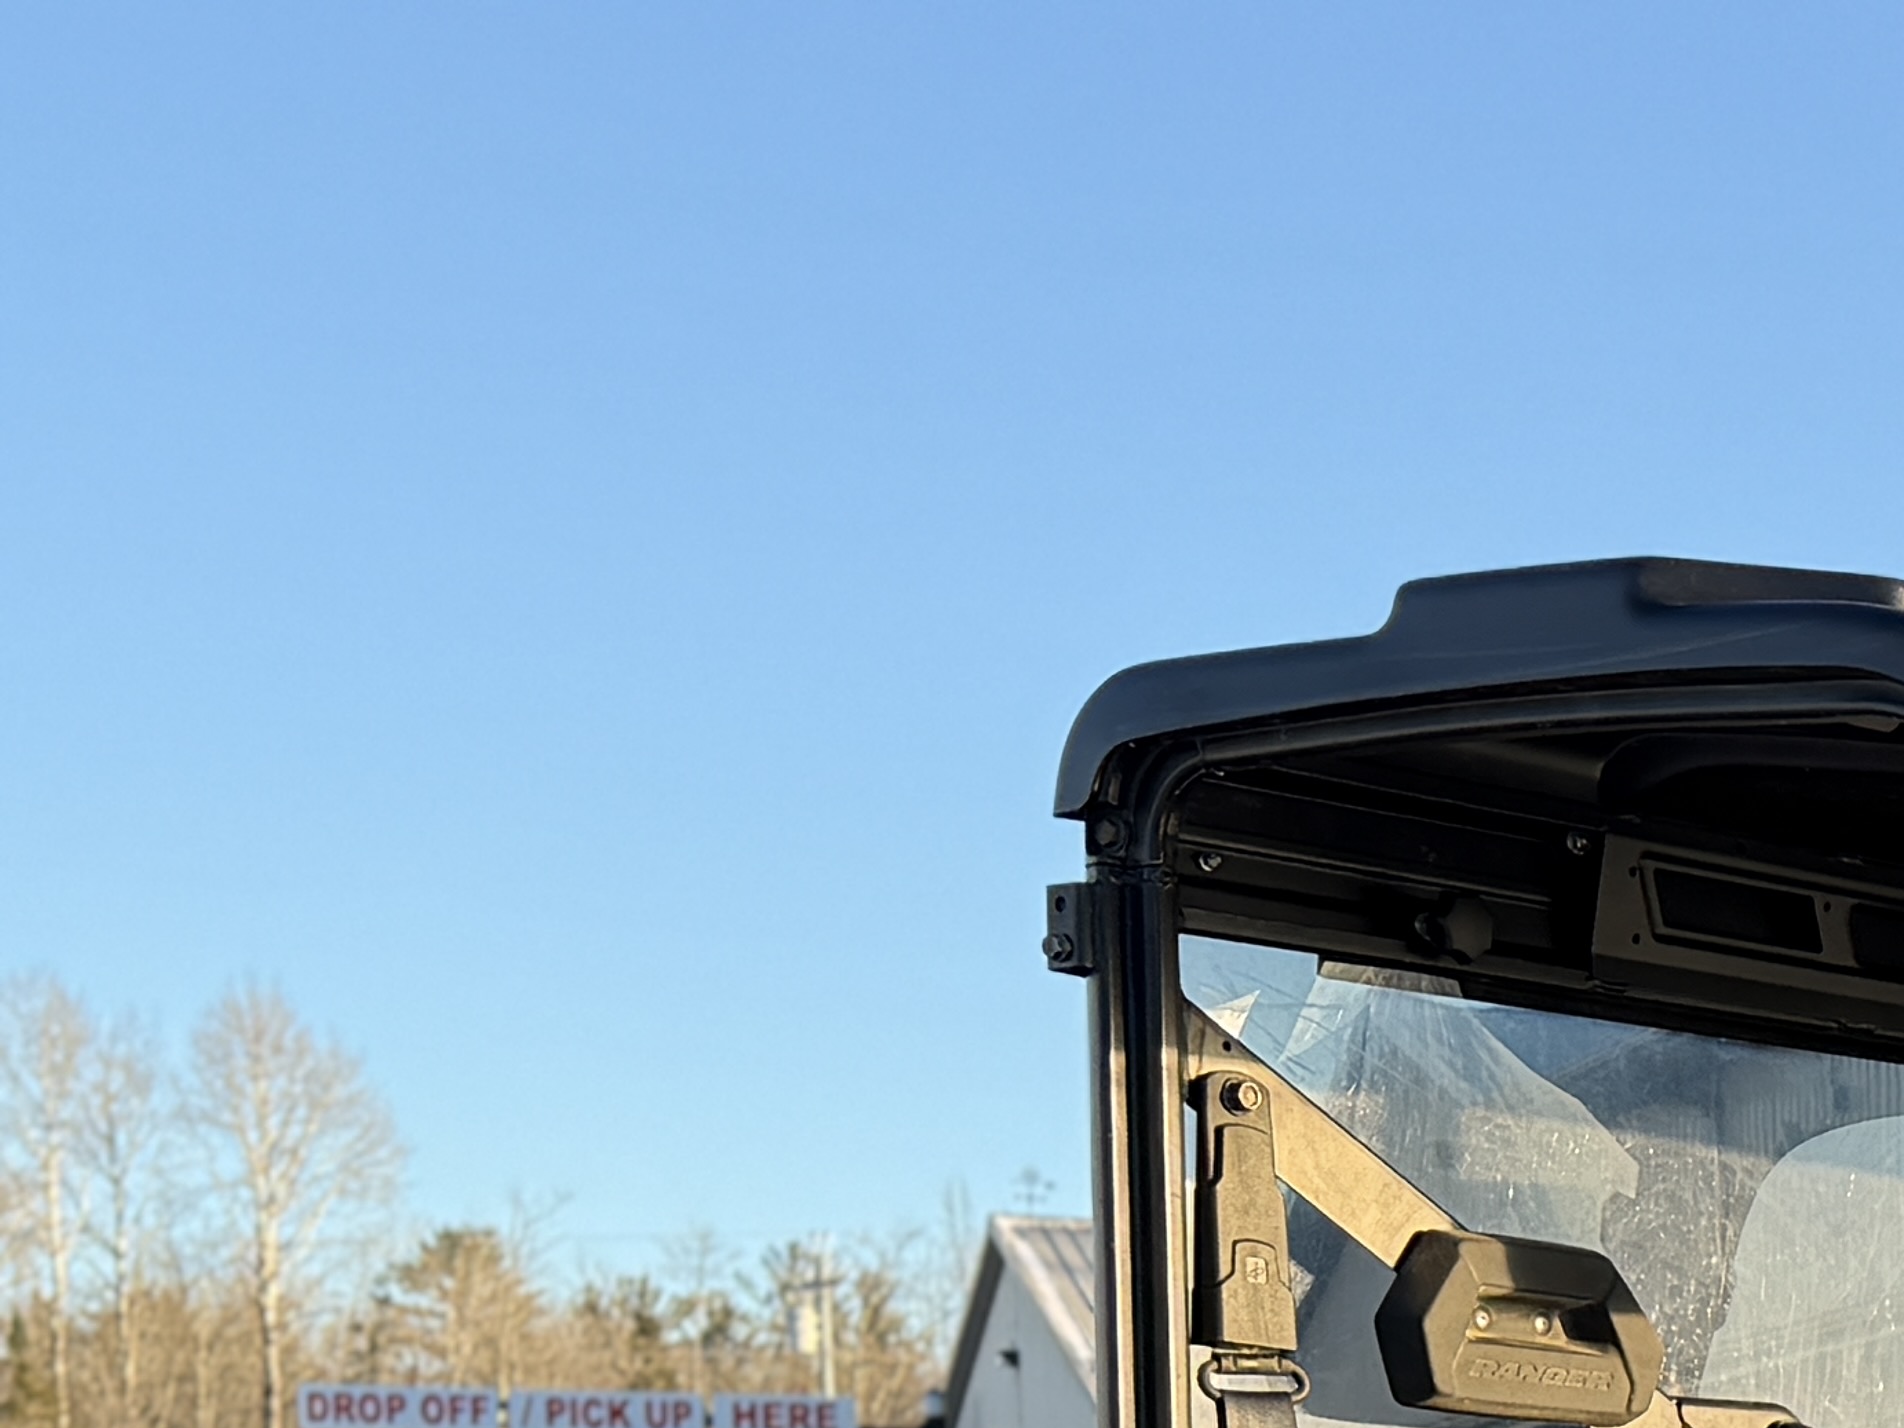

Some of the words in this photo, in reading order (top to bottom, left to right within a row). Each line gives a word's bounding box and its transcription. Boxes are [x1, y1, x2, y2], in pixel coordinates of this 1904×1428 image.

[1468, 1359, 1614, 1391] RANGER
[306, 1393, 407, 1425] DROP
[420, 1394, 489, 1426] OFF
